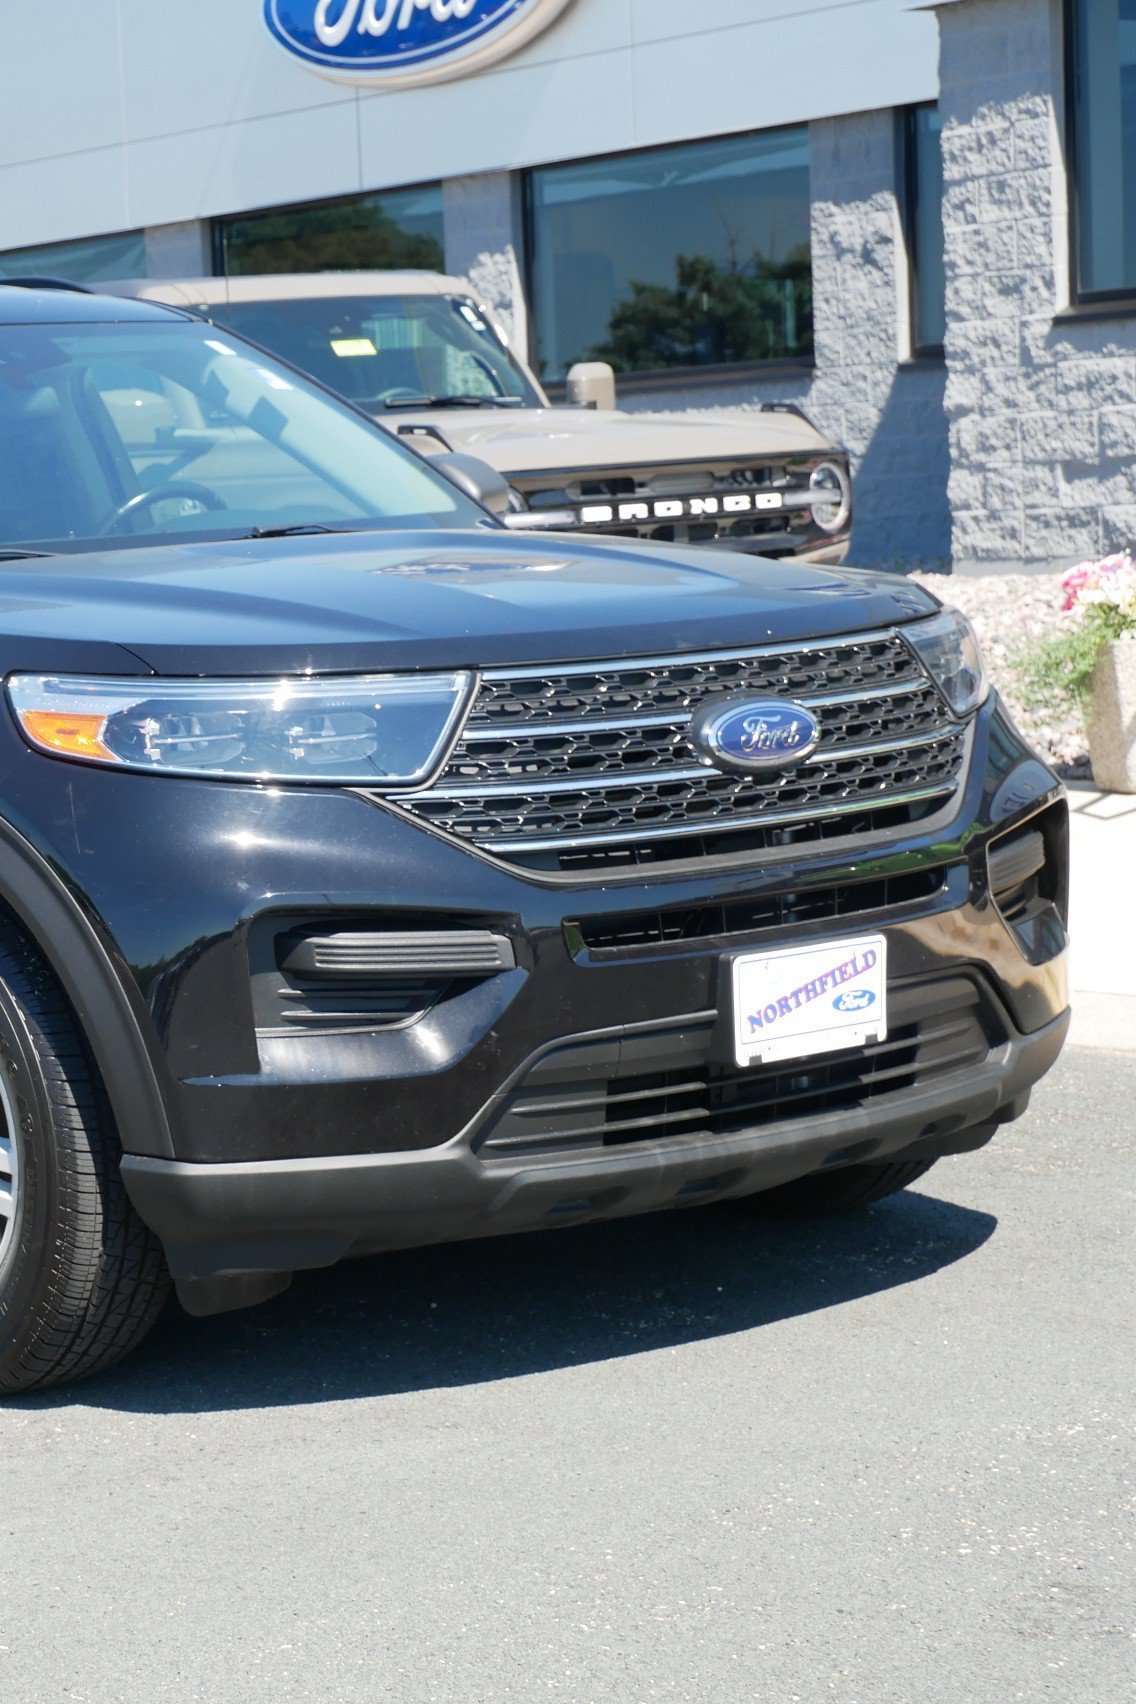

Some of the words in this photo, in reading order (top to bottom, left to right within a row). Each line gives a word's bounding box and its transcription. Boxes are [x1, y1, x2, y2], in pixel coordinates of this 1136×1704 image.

[581, 492, 782, 523] BRONCO
[740, 714, 801, 752] Ford
[747, 949, 877, 1034] NORTHFIELD
